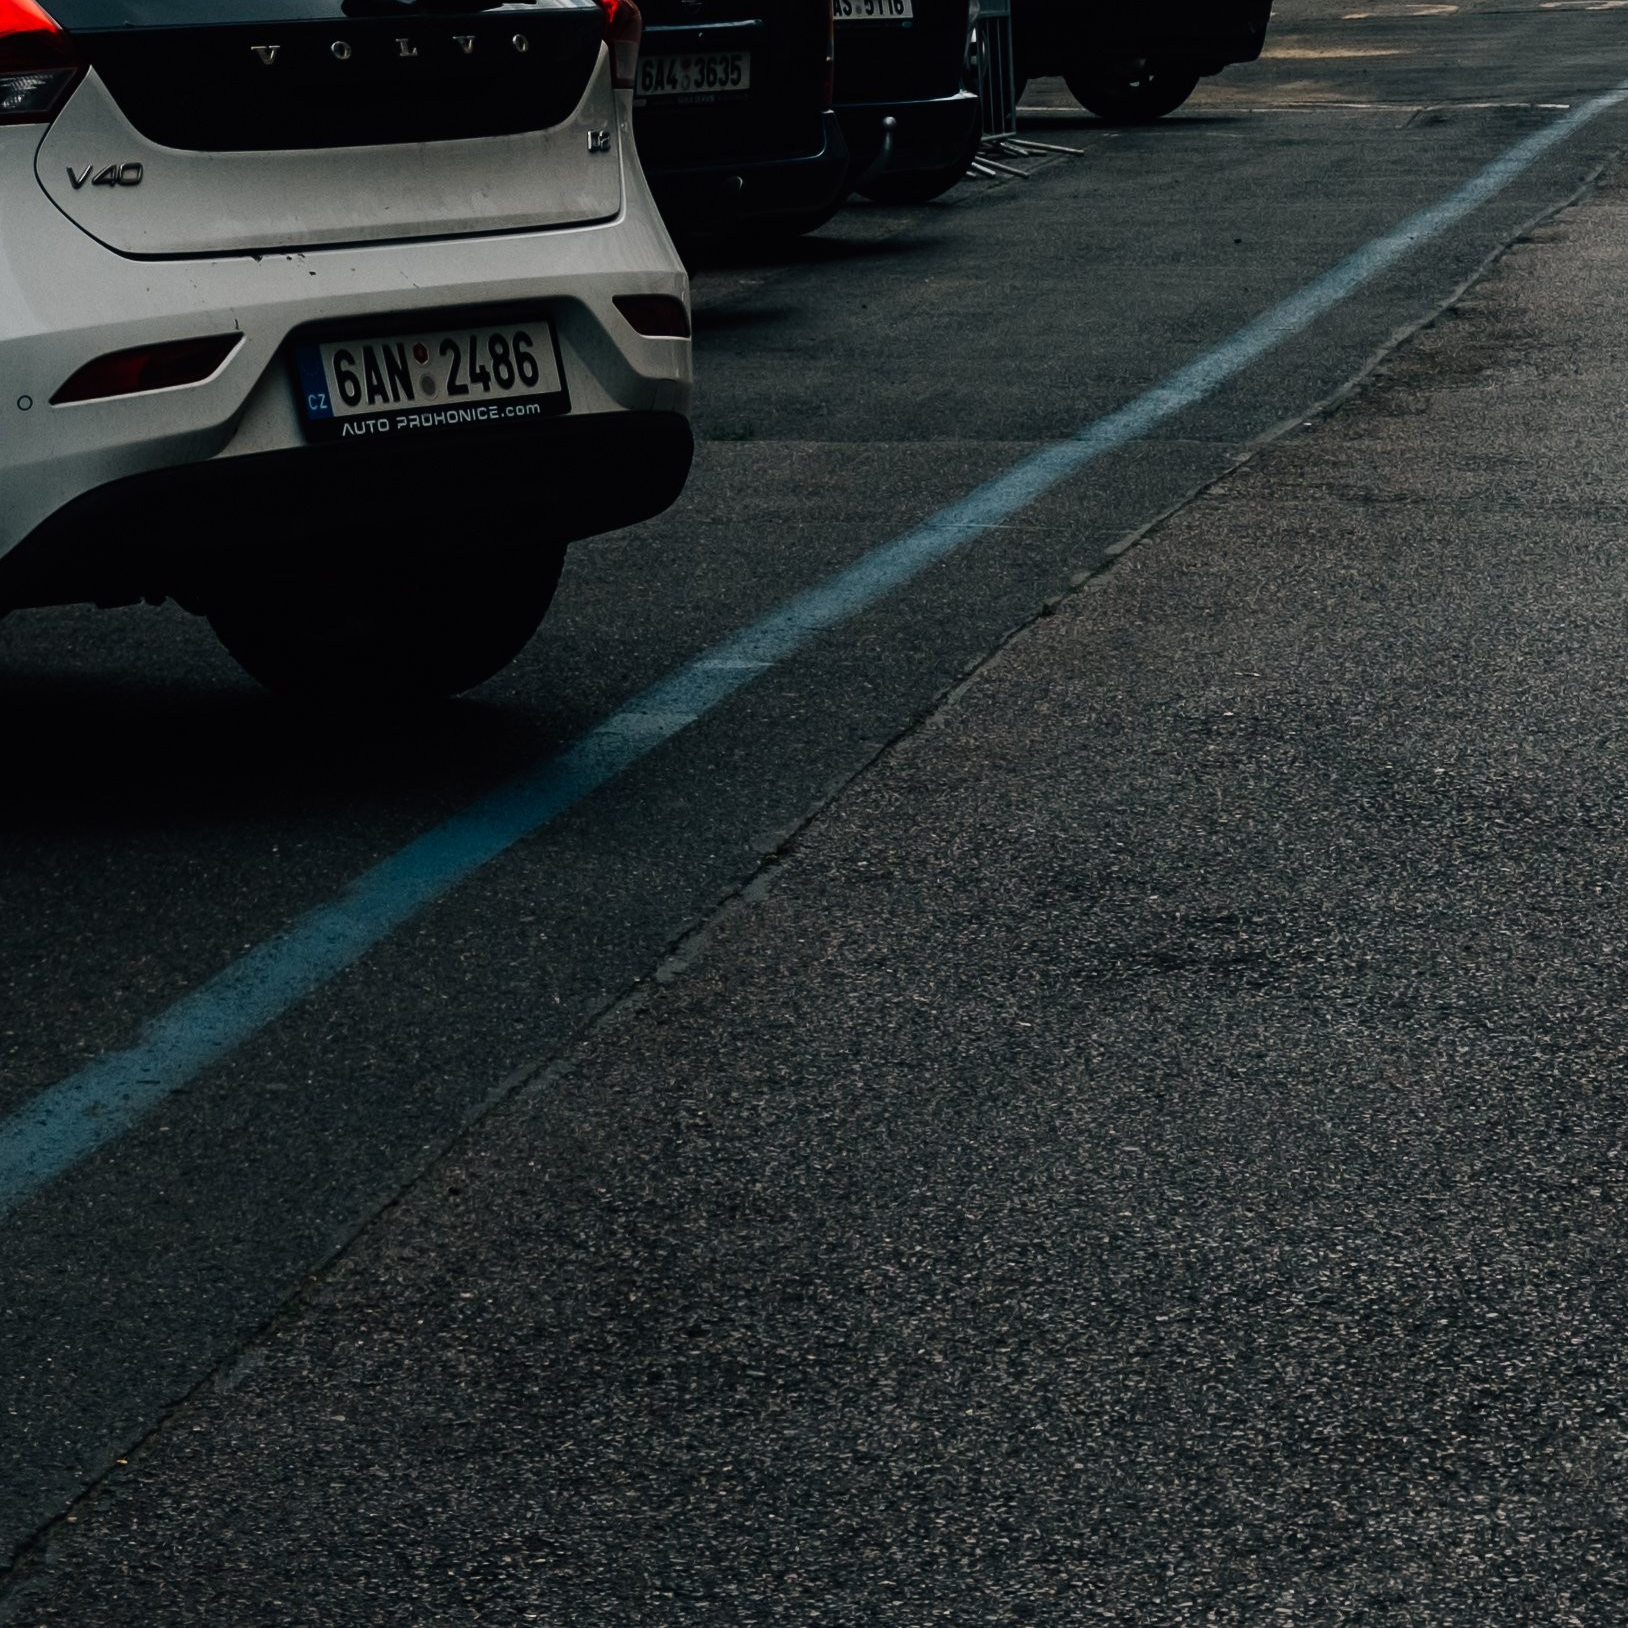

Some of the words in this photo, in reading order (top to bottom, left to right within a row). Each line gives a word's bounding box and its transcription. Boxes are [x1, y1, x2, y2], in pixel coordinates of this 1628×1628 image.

[250, 33, 530, 65] VOLVO
[641, 55, 678, 92] 6A4
[693, 54, 742, 89] 3635
[66, 161, 144, 190] V40
[308, 393, 328, 411] CZ
[333, 342, 415, 407] 6AN
[439, 330, 540, 397] 2486
[342, 418, 390, 437] AUTO
